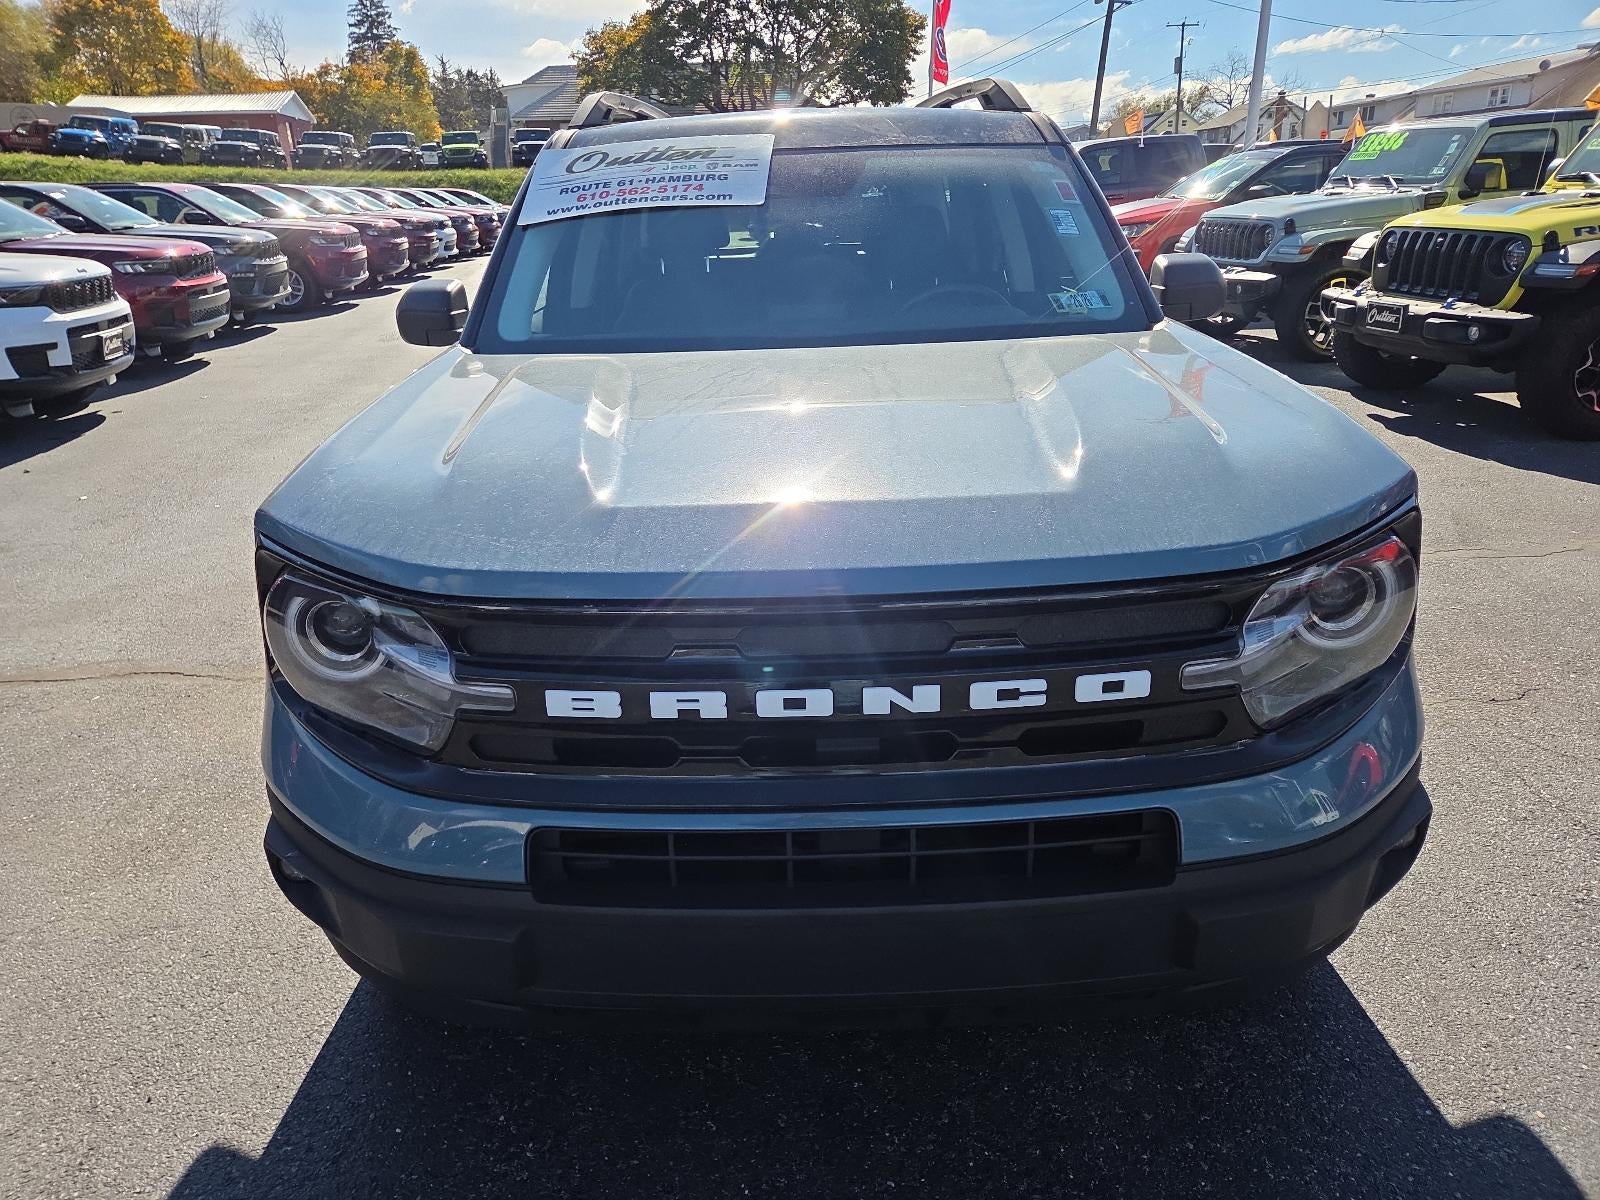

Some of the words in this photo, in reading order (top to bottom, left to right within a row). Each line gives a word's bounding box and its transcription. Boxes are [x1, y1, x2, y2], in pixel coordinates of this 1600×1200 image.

[565, 146, 736, 174] Outten
[559, 181, 612, 195] ROUTE
[576, 184, 704, 202] 610-562-5174
[547, 193, 733, 215] www.outtencars.com
[1368, 308, 1400, 323] Outten
[544, 669, 1152, 719] BRONCO
